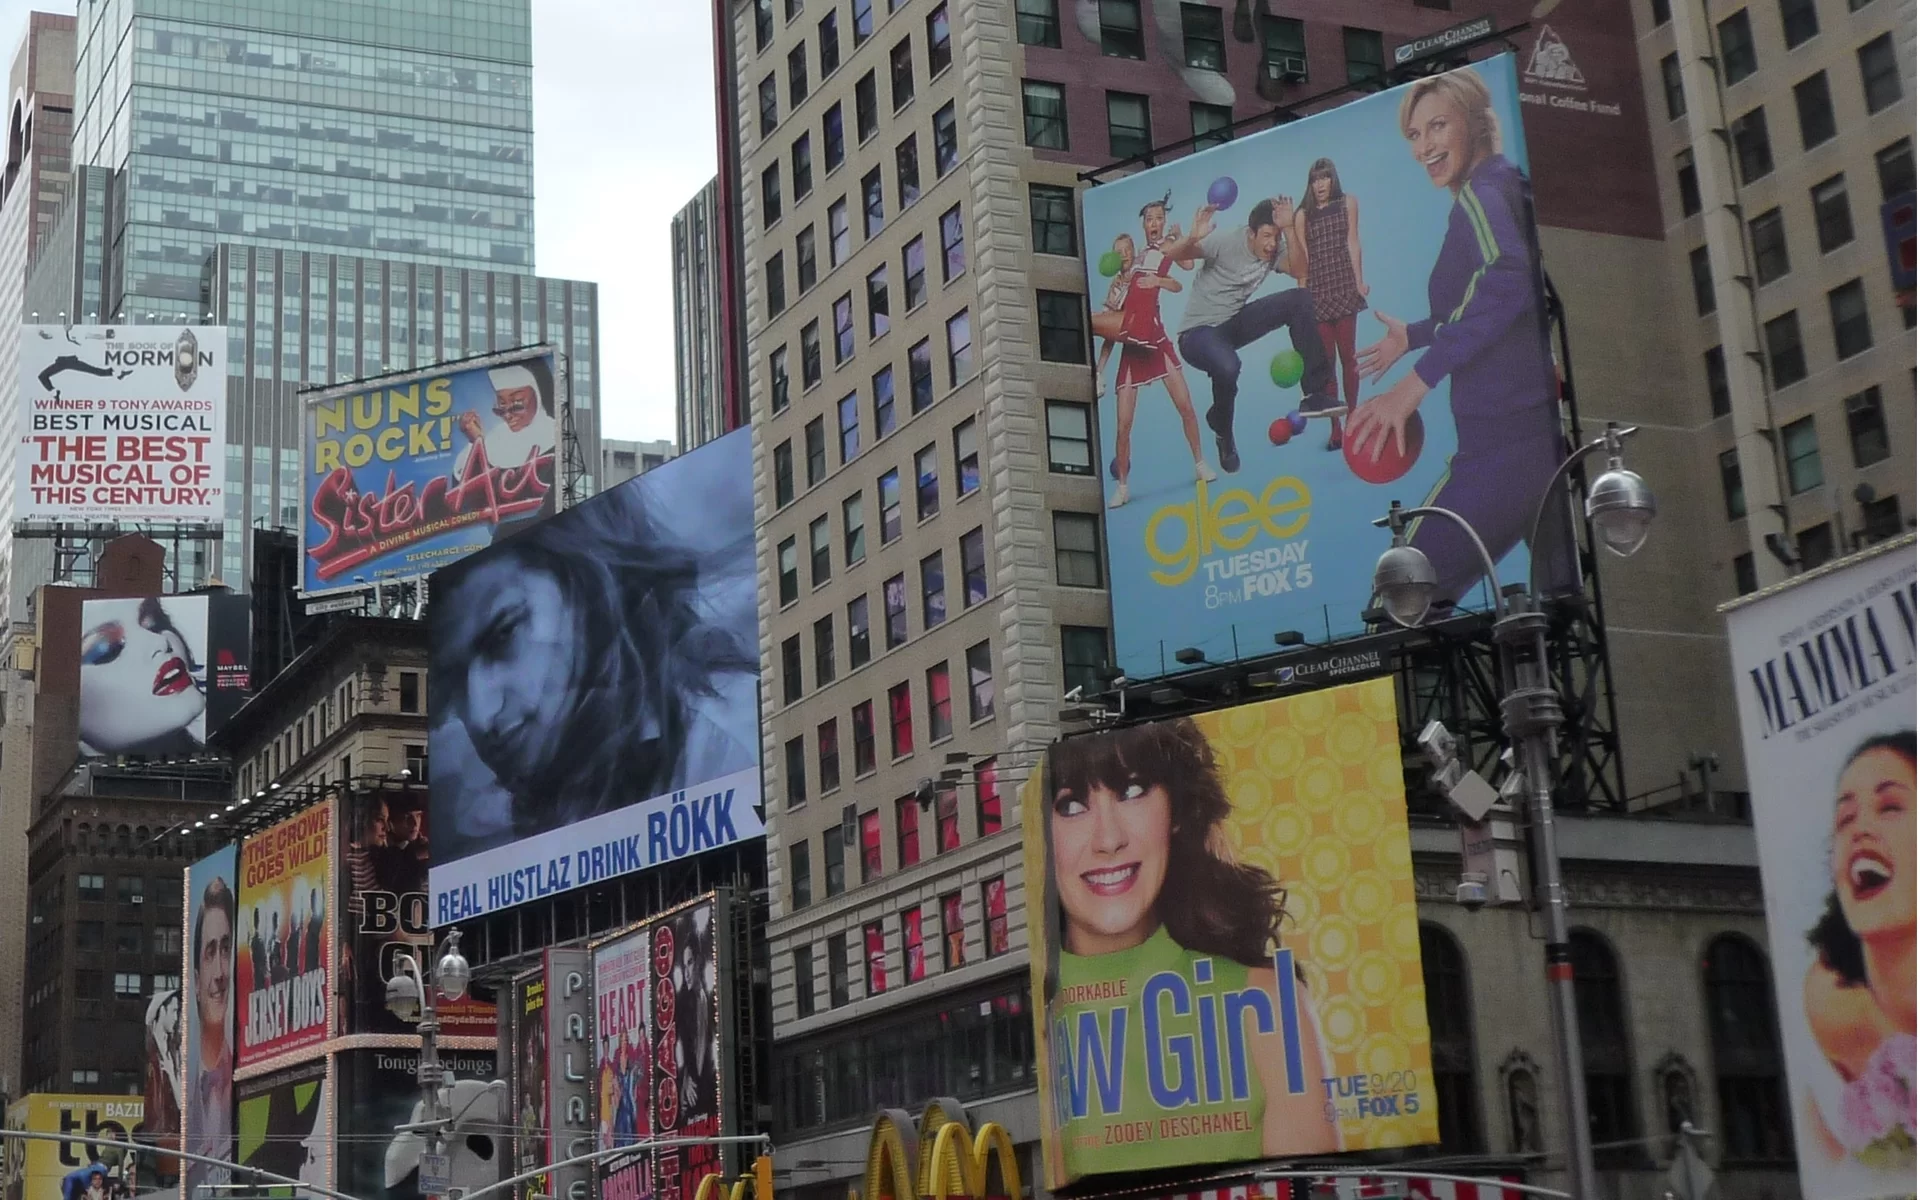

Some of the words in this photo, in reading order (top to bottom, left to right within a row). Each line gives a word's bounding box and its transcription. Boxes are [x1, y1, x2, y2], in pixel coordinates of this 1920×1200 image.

[1550, 96, 1588, 111] Coffee
[1590, 100, 1621, 115] Fund
[128, 342, 157, 350] BOOK
[160, 342, 173, 350] OF
[33, 414, 94, 430] BEST
[103, 414, 212, 431] MUSICAL
[34, 399, 93, 410] WINNER
[97, 399, 106, 410] 9
[110, 399, 149, 410] TONY
[151, 400, 212, 410] AWARDS
[315, 378, 452, 438] NUNS
[116, 436, 211, 462] BEST
[31, 464, 162, 485] MUSICAL
[170, 465, 211, 485] OF
[31, 487, 86, 505] THIS
[309, 466, 447, 560] Sister
[445, 437, 555, 523] Act
[370, 545, 378, 554] A
[379, 531, 410, 549] DIVINE
[413, 518, 449, 537] MUSICAL
[451, 511, 481, 526] COMEDY
[1145, 475, 1312, 587] glee
[1203, 539, 1309, 582] TUESDAY
[1205, 585, 1242, 609] 8PM
[1243, 567, 1292, 601] FOX
[1296, 563, 1313, 589] 5
[1330, 661, 1381, 676] SPECTACOLOR
[1750, 606, 1897, 740] MAMMA
[277, 808, 329, 851] CROWD
[247, 852, 284, 888] GOES
[438, 883, 482, 924] REAL
[487, 854, 571, 911] HUSTLAZ
[577, 834, 641, 881] DRINK
[648, 788, 738, 864] RÖKK
[245, 980, 291, 1047] JERSEY
[293, 967, 325, 1032] BOYS
[599, 979, 645, 1040] HEART
[1141, 948, 1305, 1110] Girl
[564, 971, 586, 1200] PALACE
[1321, 1075, 1369, 1098] TUE
[1371, 1070, 1416, 1094] 9/20
[1358, 1095, 1401, 1119] FOX
[1404, 1092, 1420, 1115] 5
[1104, 1121, 1154, 1145] ZOOEY
[1160, 1110, 1253, 1140] DESCHANEL
